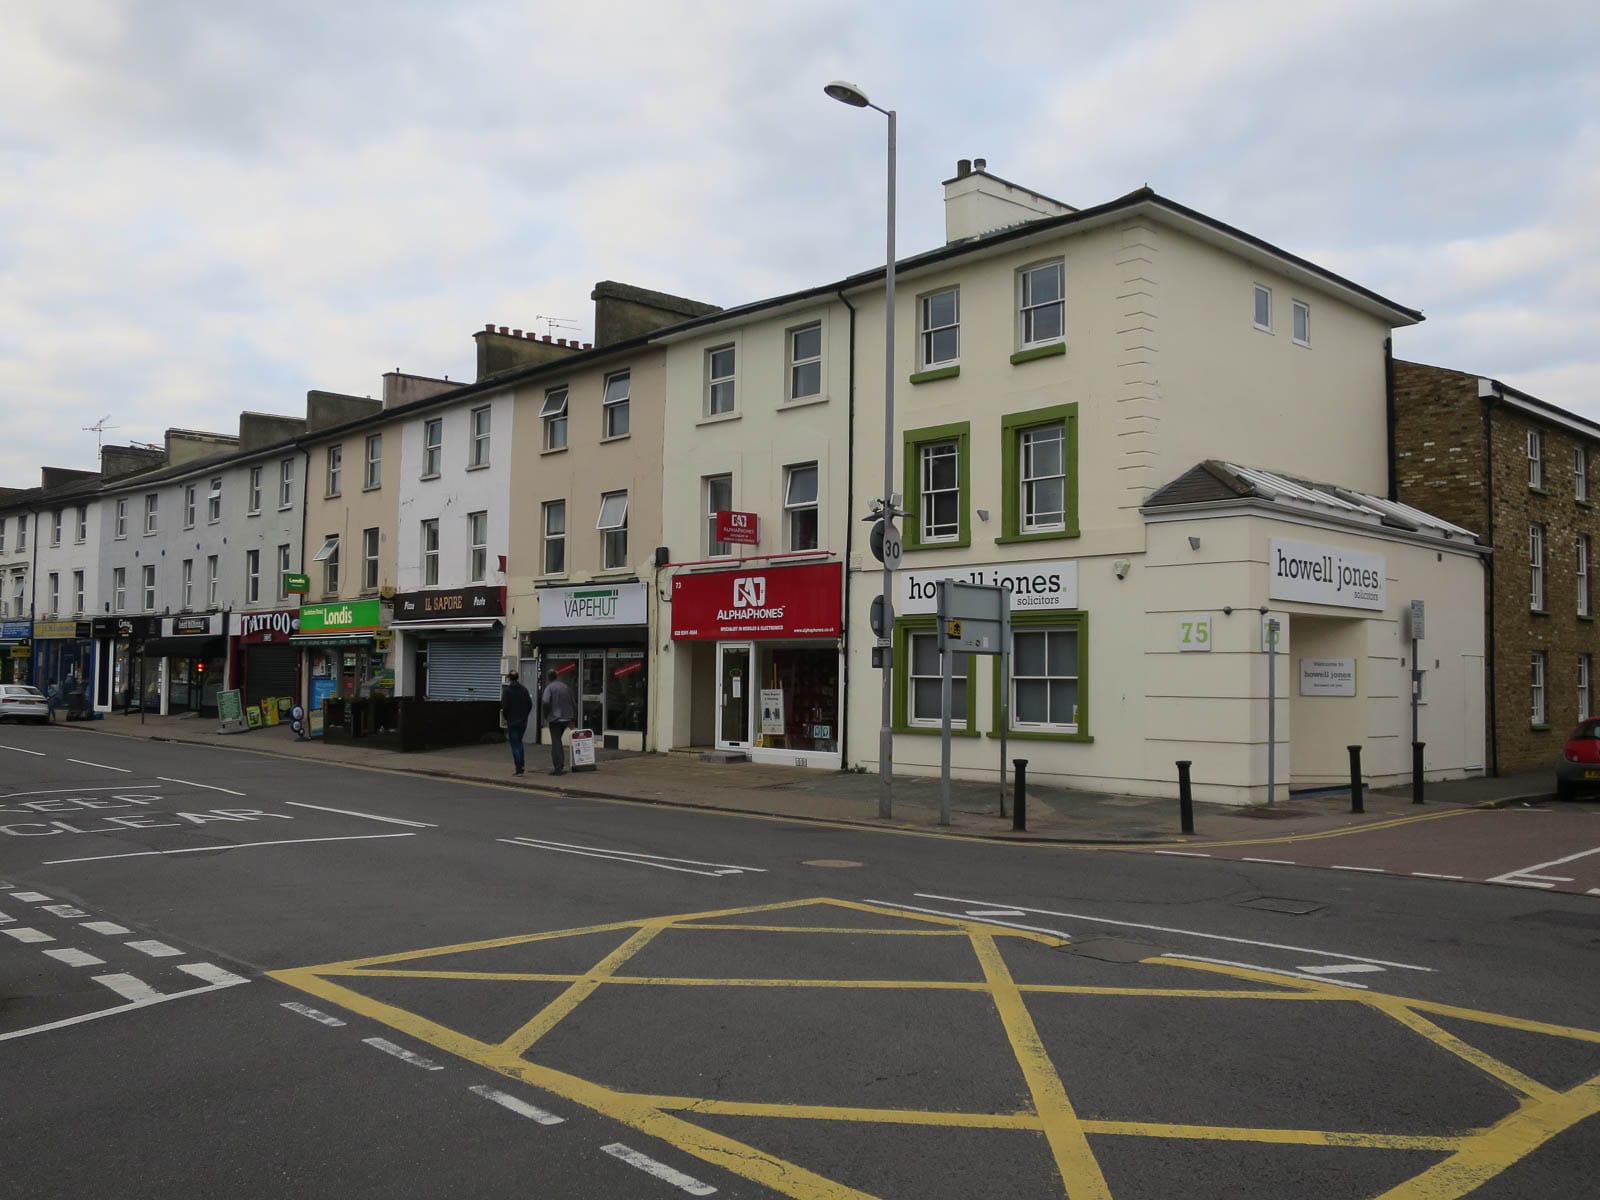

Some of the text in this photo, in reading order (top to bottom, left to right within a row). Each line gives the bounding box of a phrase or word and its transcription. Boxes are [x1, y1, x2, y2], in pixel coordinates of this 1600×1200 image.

[885, 540, 900, 559] 30
[1277, 548, 1333, 583] howell
[908, 571, 984, 600] holl
[433, 595, 463, 610] SAPORE
[1017, 594, 1060, 606] solicitors
[241, 612, 291, 637] TATTOO
[324, 605, 353, 625] Londis
[1181, 622, 1208, 644] 75
[1304, 670, 1329, 678] howell
[0, 808, 294, 836] CLEAR
